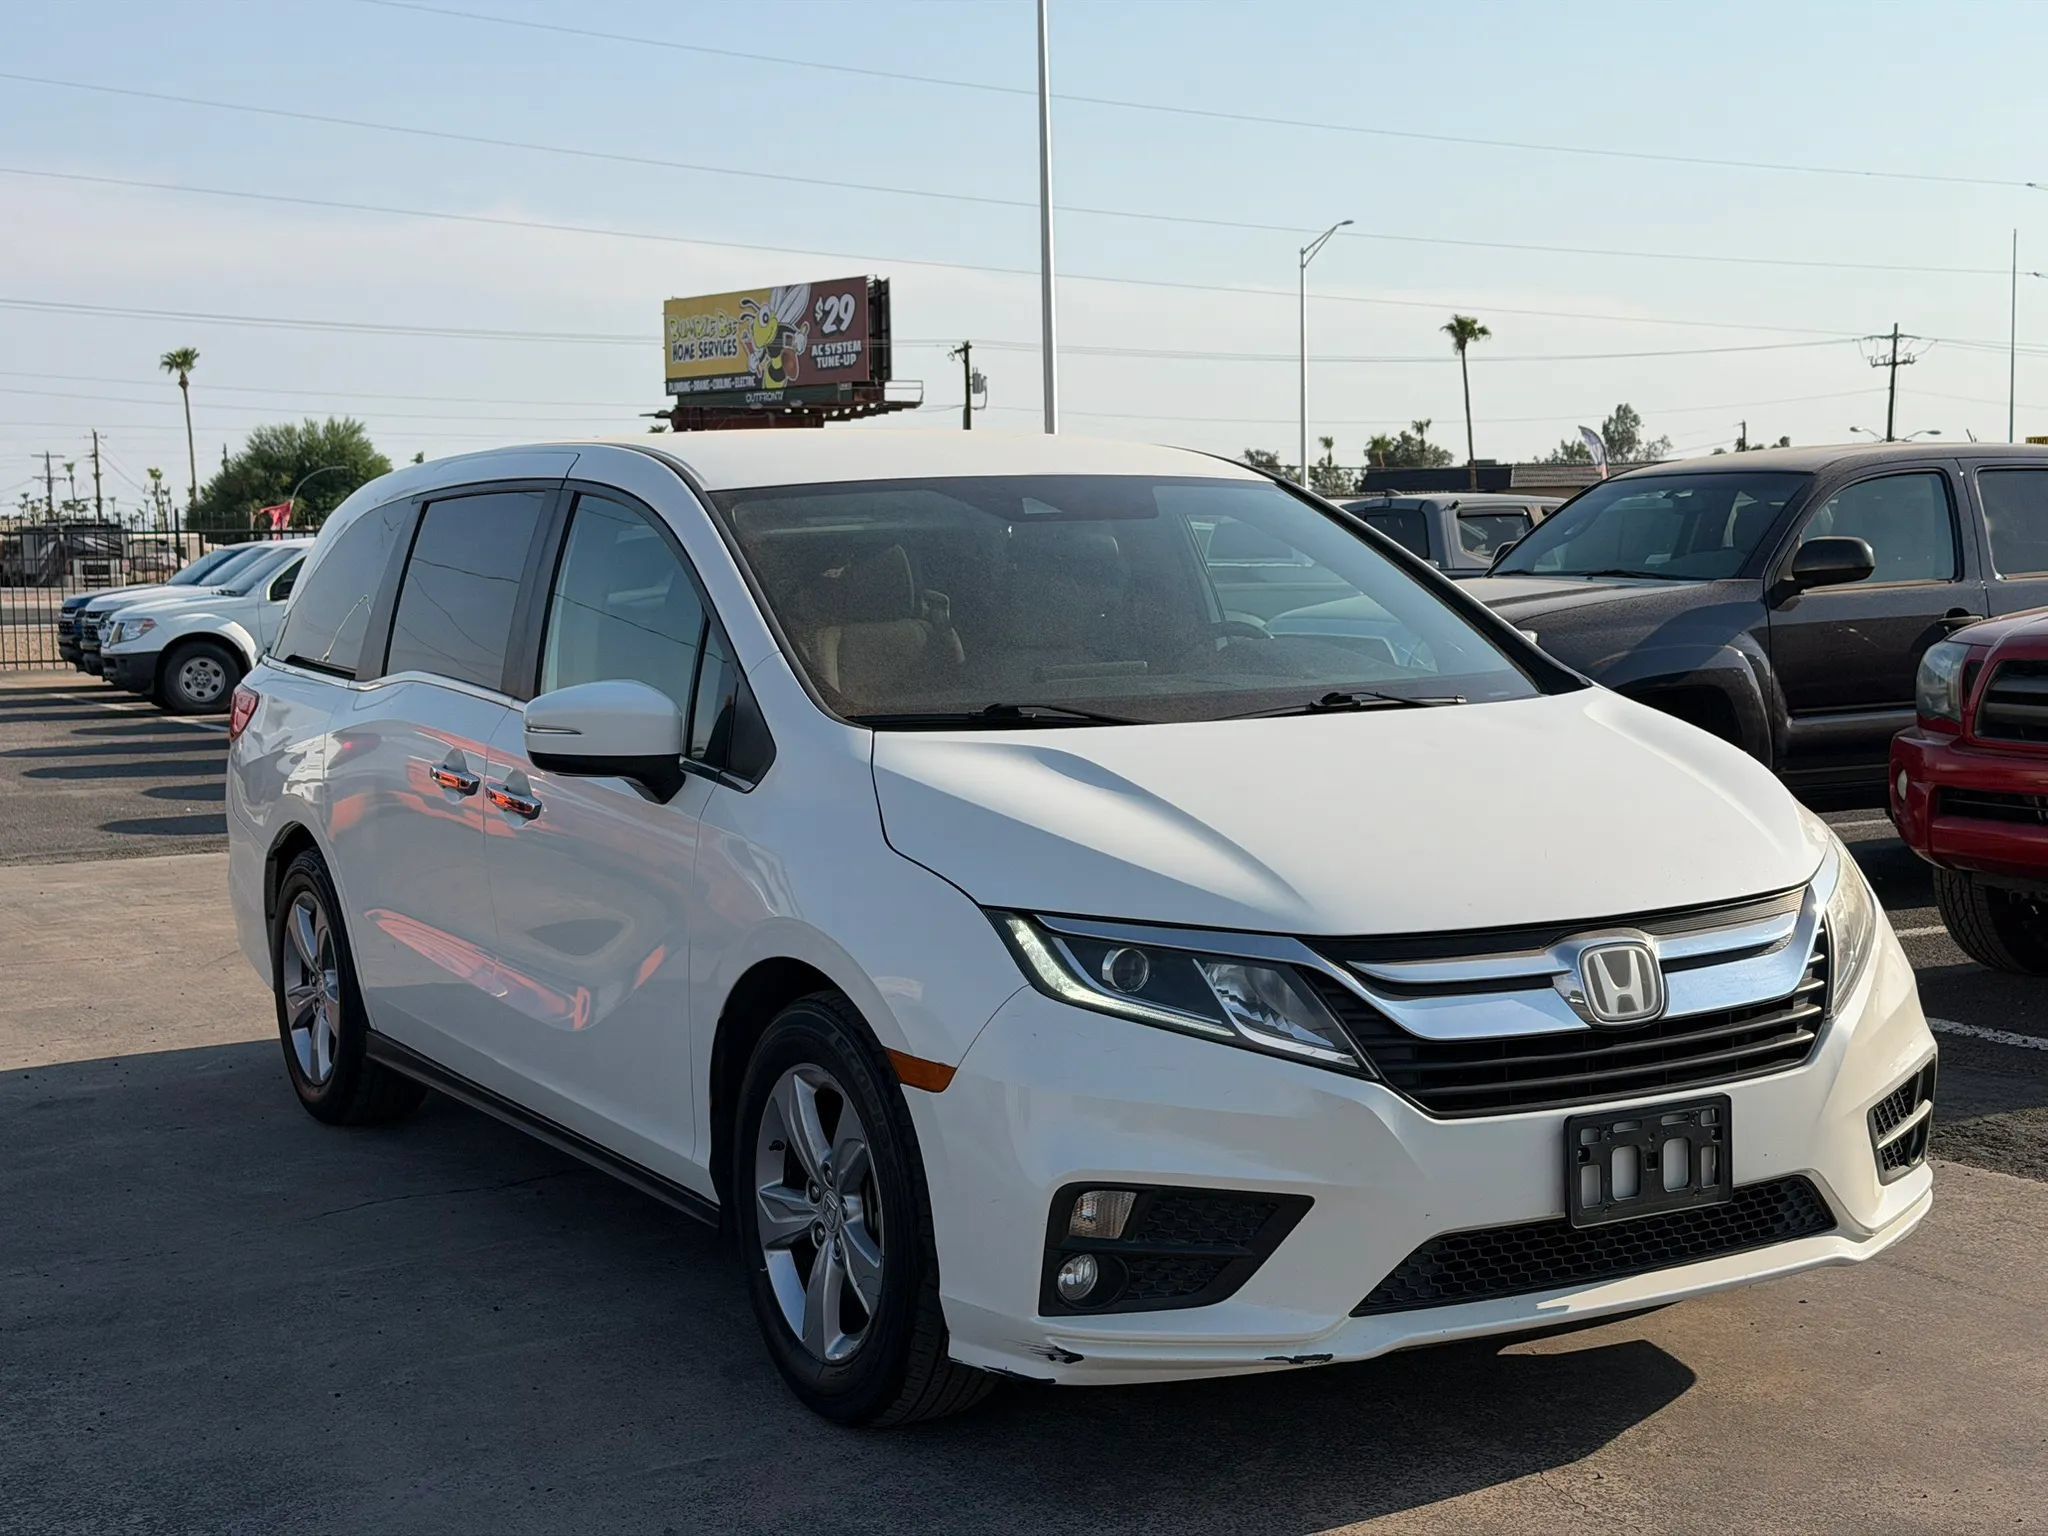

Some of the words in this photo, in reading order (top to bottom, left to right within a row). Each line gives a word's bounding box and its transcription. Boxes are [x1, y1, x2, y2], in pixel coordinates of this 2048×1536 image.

[814, 293, 856, 334] $29
[672, 343, 696, 362] HOME
[698, 338, 738, 359] SERVICES
[811, 344, 824, 357] AC
[825, 340, 862, 355] SYSTEM
[816, 353, 857, 368] TUNE-UP
